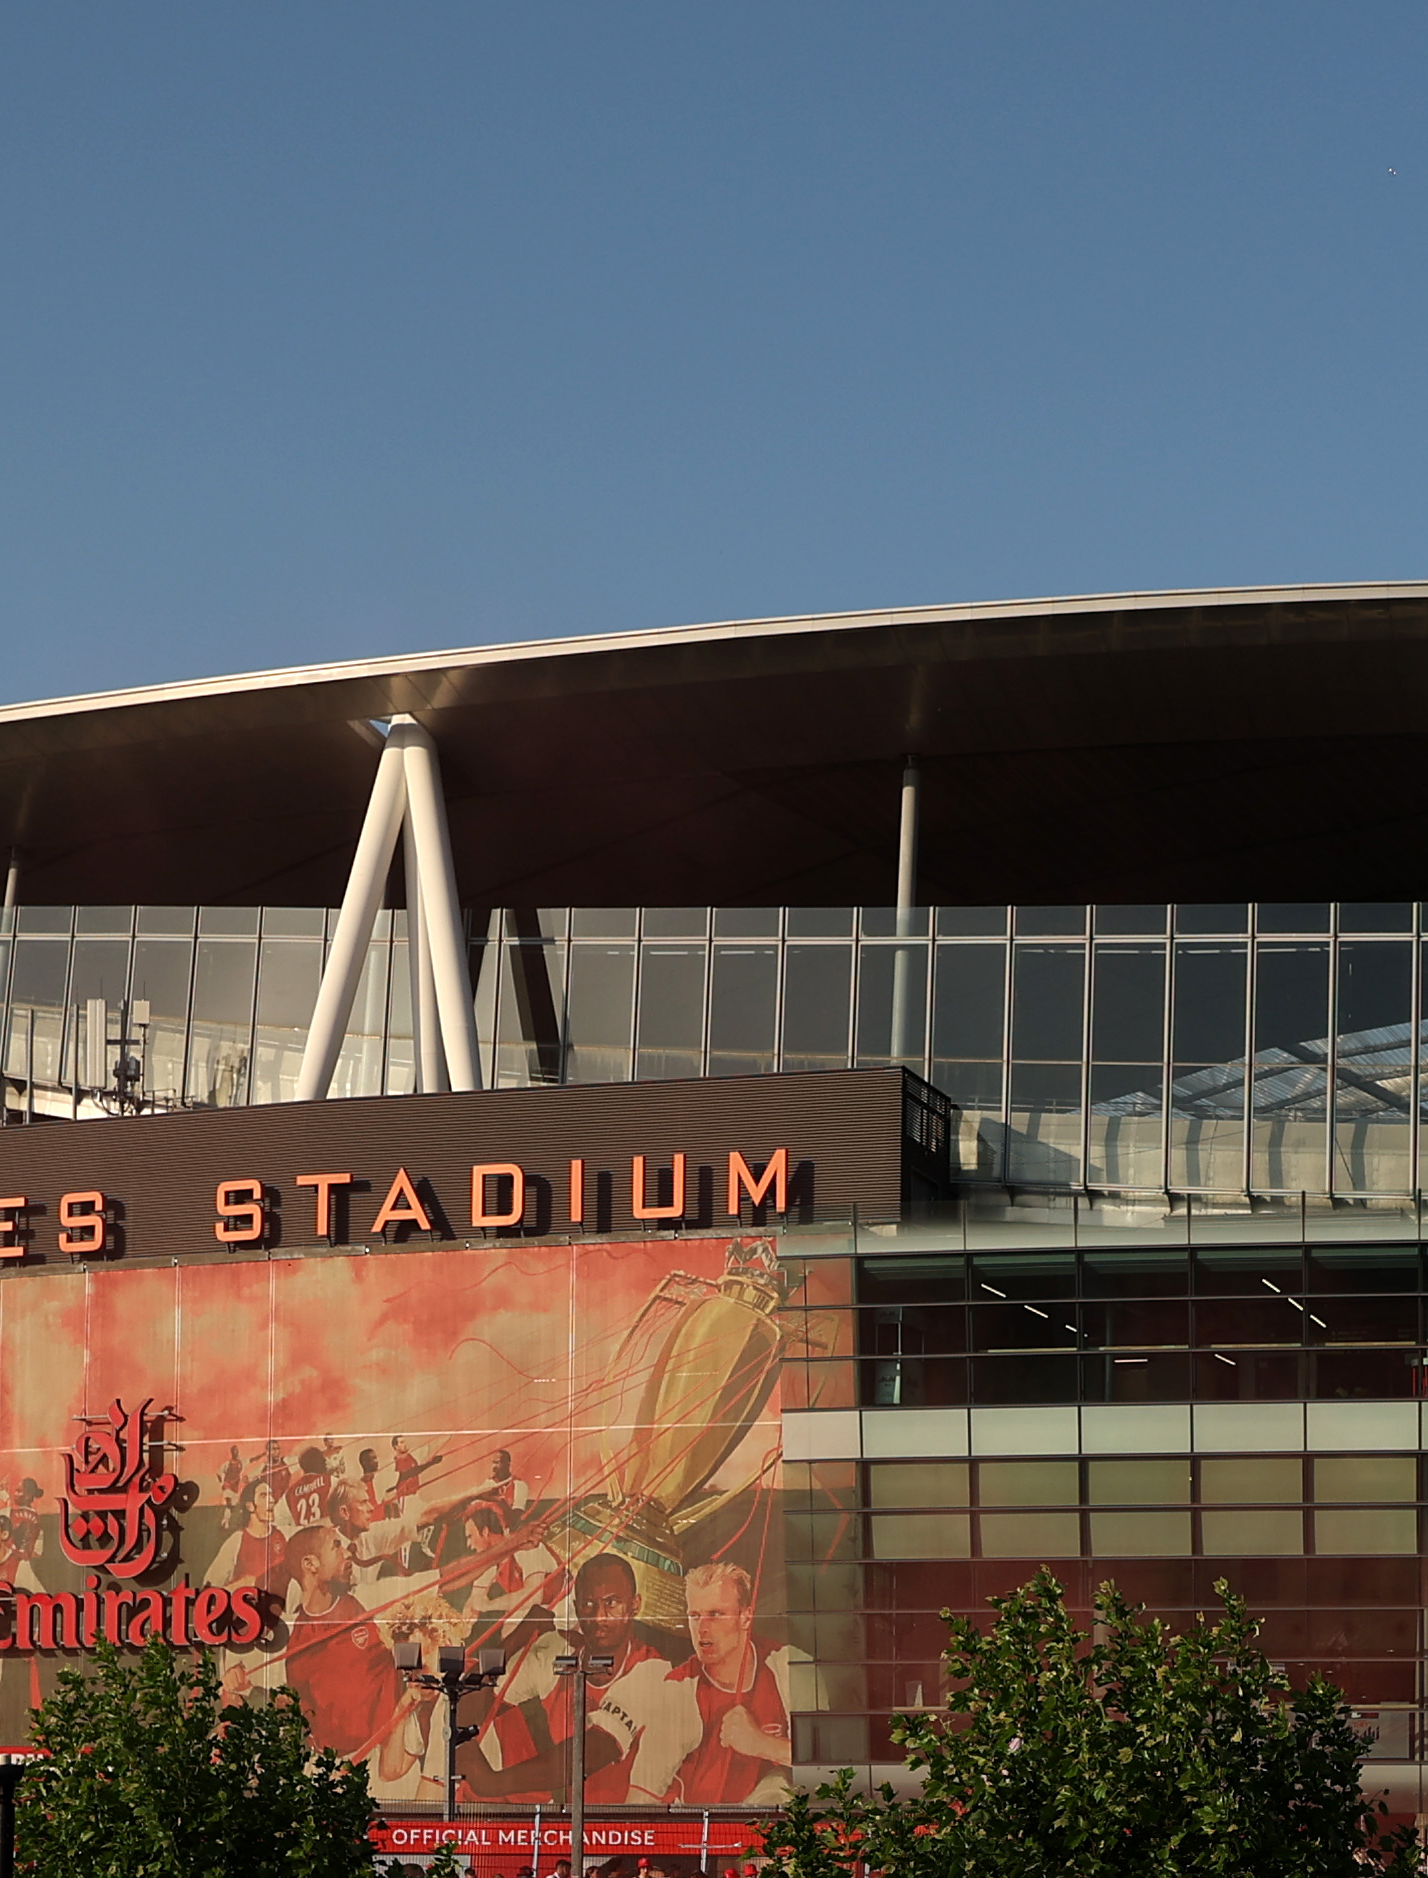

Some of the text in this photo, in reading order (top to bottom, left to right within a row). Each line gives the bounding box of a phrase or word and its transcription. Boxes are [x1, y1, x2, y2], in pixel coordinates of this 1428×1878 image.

[214, 1147, 789, 1243] STADIUM
[297, 1496, 322, 1525] 23
[392, 1829, 655, 1847] OFFICIAL MERCHANDISE
